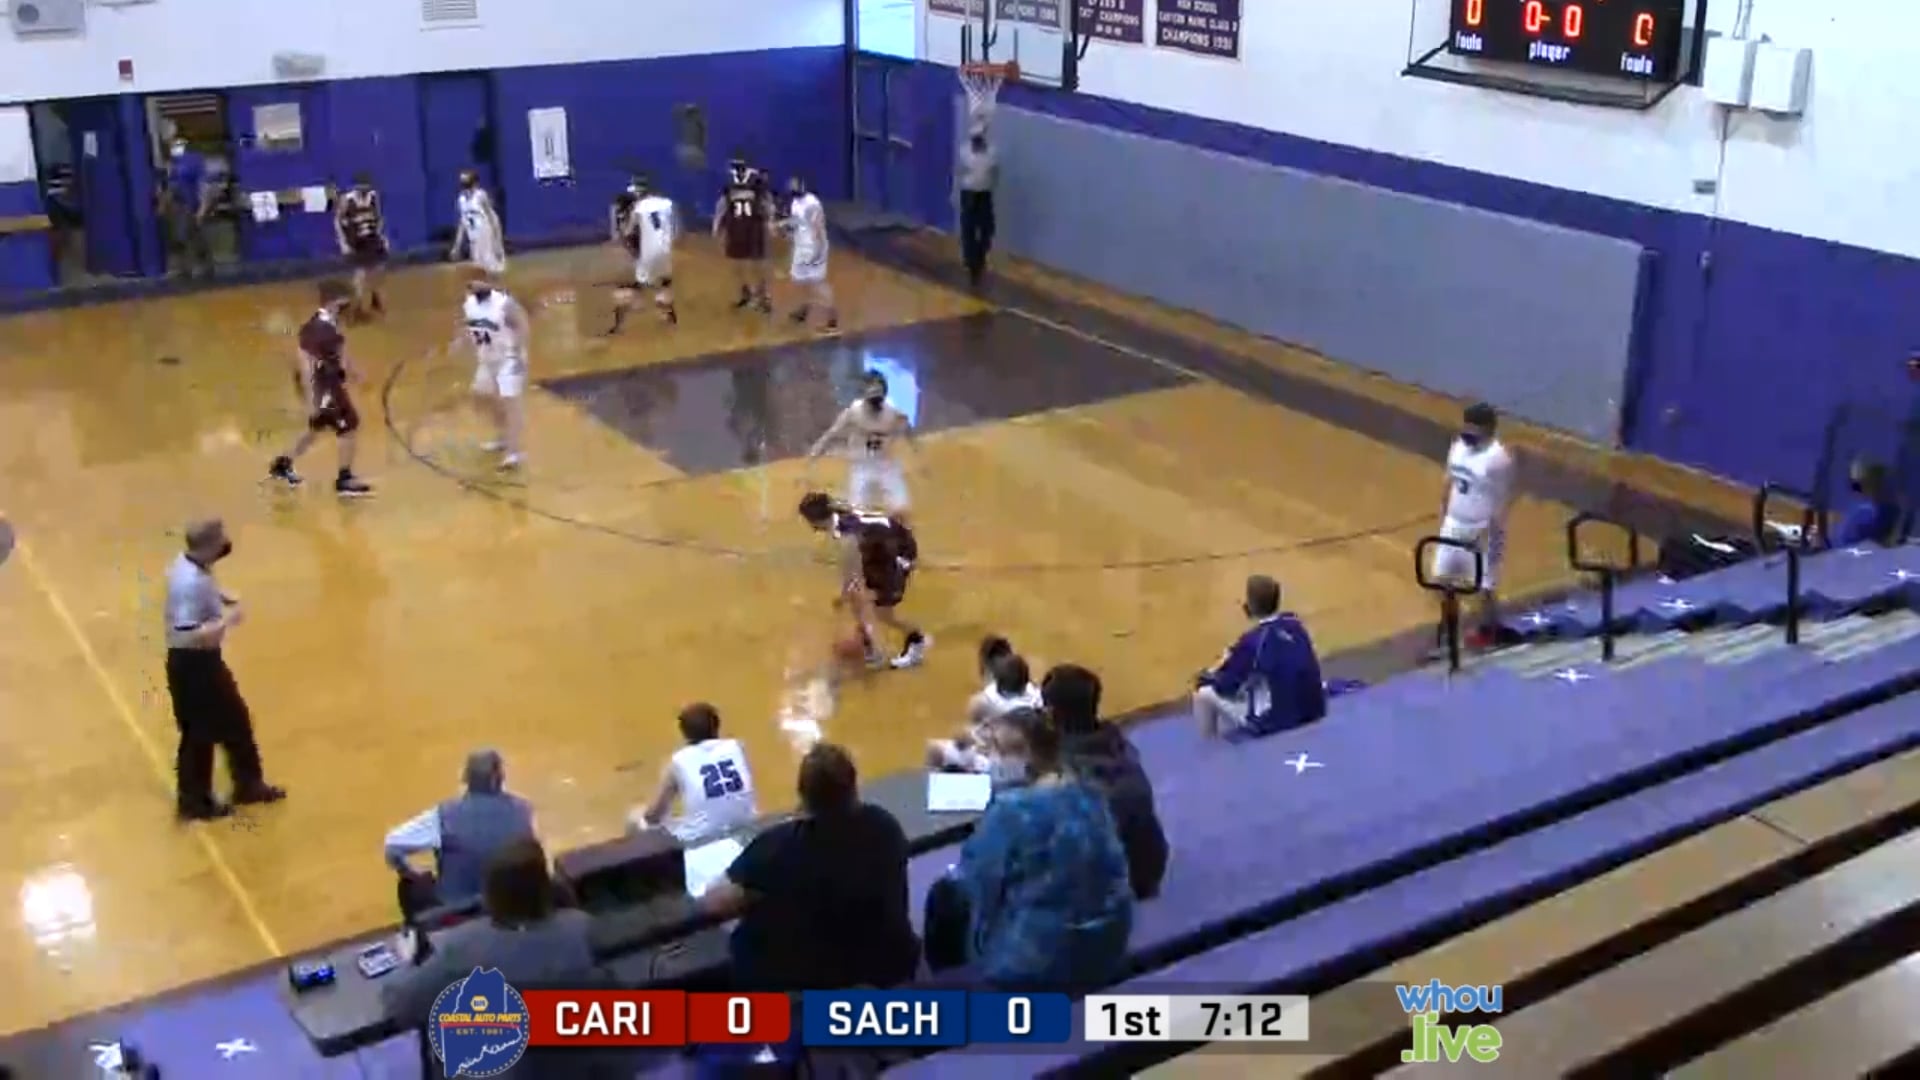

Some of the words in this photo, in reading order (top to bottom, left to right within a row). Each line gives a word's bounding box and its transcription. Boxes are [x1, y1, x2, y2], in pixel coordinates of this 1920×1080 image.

[1099, 11, 1140, 26] CHAMPIONS
[1162, 28, 1210, 48] CHAMPIONS
[1529, 40, 1571, 62] player
[700, 759, 744, 799] 25
